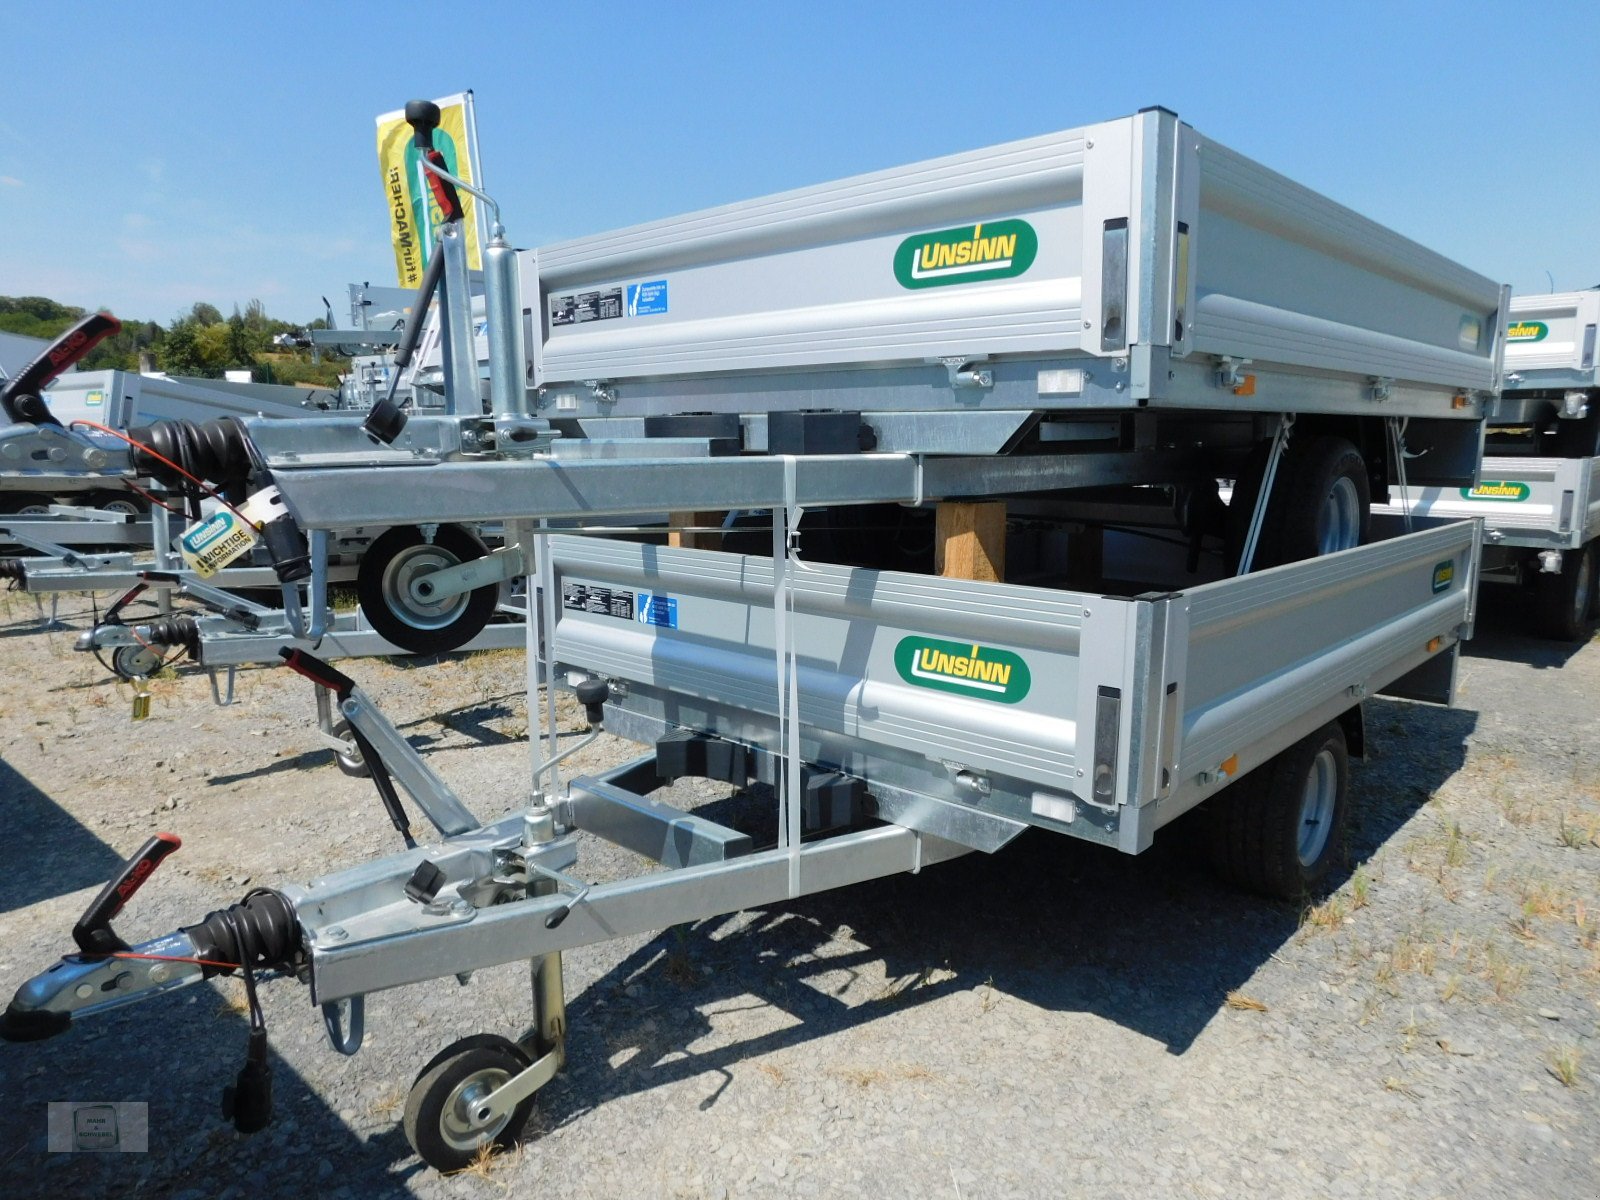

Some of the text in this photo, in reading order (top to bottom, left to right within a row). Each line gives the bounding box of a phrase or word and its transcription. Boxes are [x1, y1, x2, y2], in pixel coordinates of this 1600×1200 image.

[921, 223, 1017, 269] UNSINN
[1508, 322, 1540, 337] SINN
[49, 331, 87, 367] AL-KO
[202, 529, 247, 565] WICHTIGE
[207, 536, 252, 571] INFORMATION
[921, 644, 1011, 685] UNSINN
[118, 859, 152, 896] AL-KO
